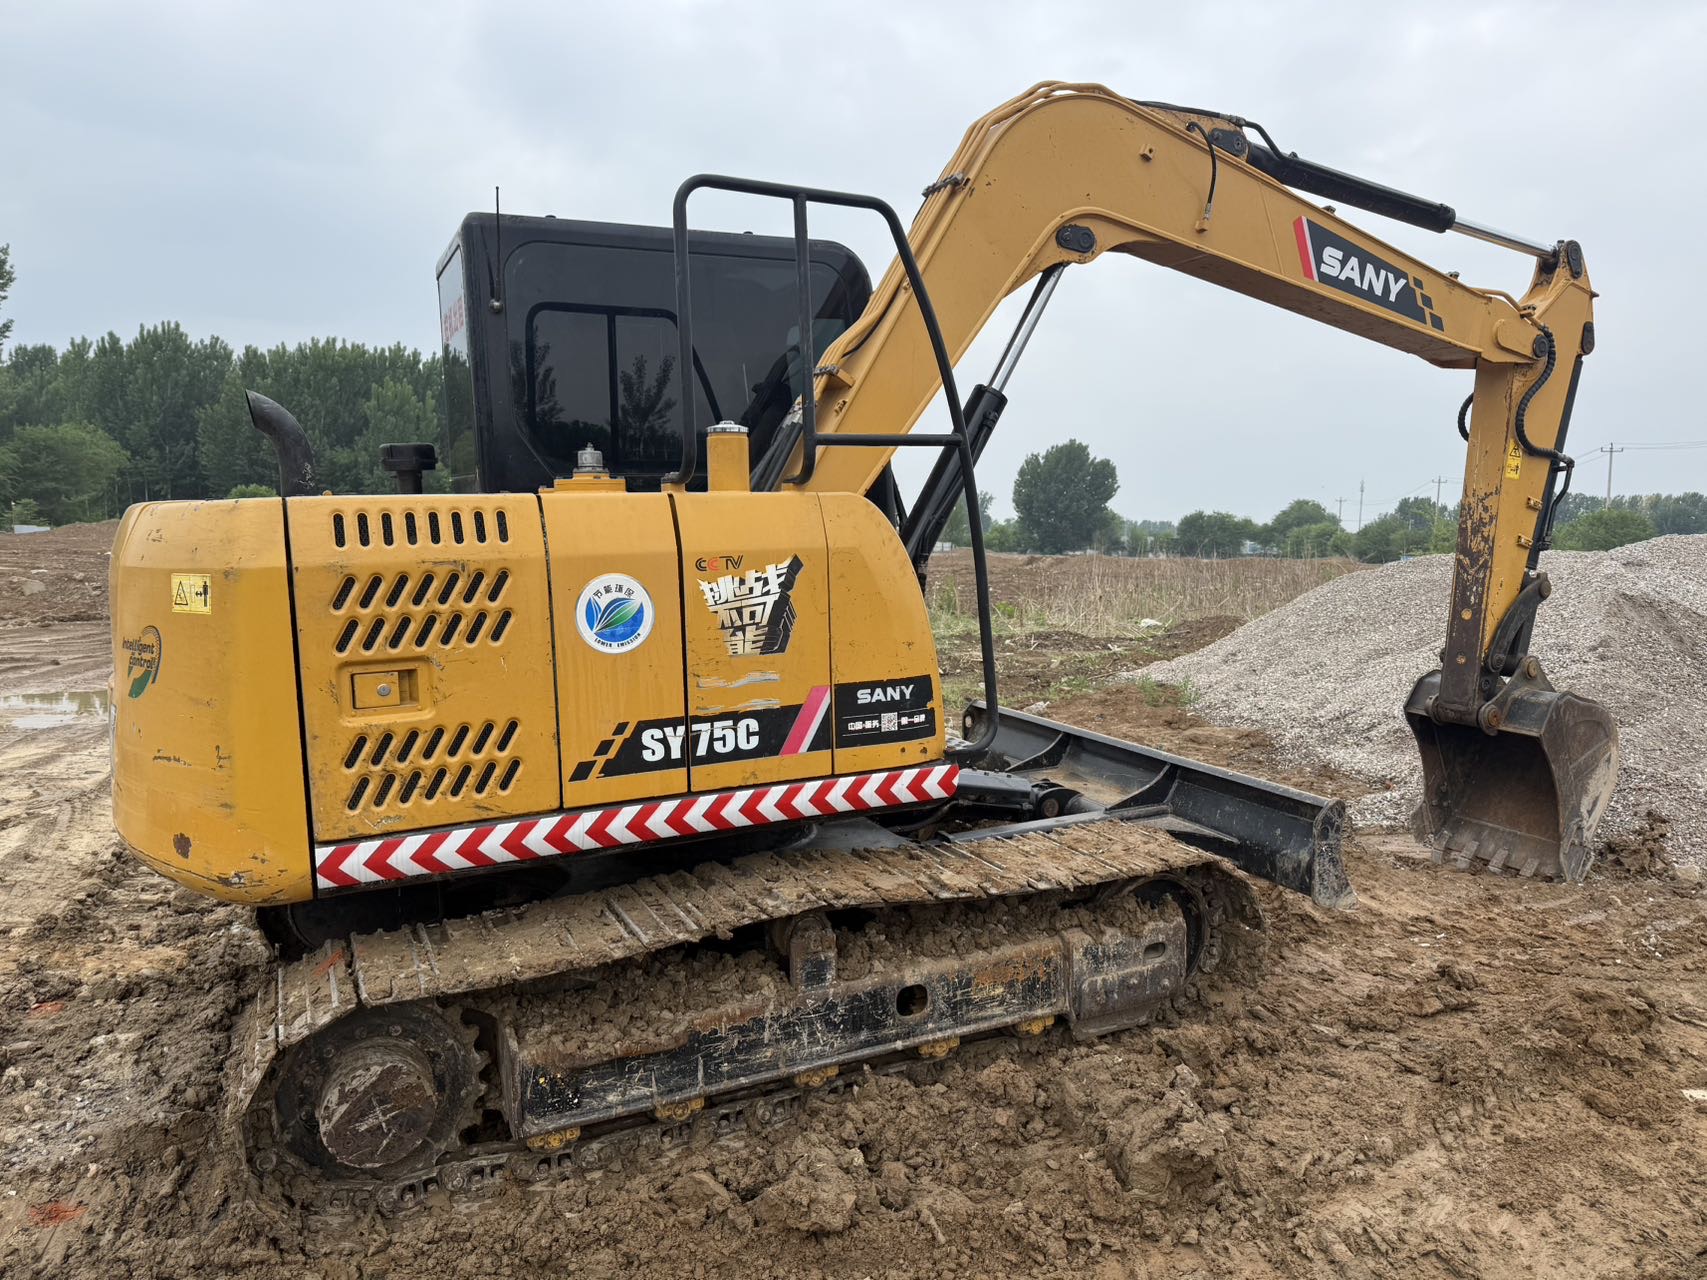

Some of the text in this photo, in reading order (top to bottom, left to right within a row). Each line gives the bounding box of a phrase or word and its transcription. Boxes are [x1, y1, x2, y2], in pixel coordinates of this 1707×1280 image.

[1319, 246, 1407, 302] SANY
[695, 554, 744, 572] CCTV
[592, 584, 635, 599] 节能环保
[697, 553, 803, 606] 挑战
[706, 592, 780, 630] 不可
[594, 632, 641, 648] LOWER EMISSION
[722, 625, 769, 656] 能
[857, 684, 915, 704] SANY
[641, 718, 760, 762] SY75C
